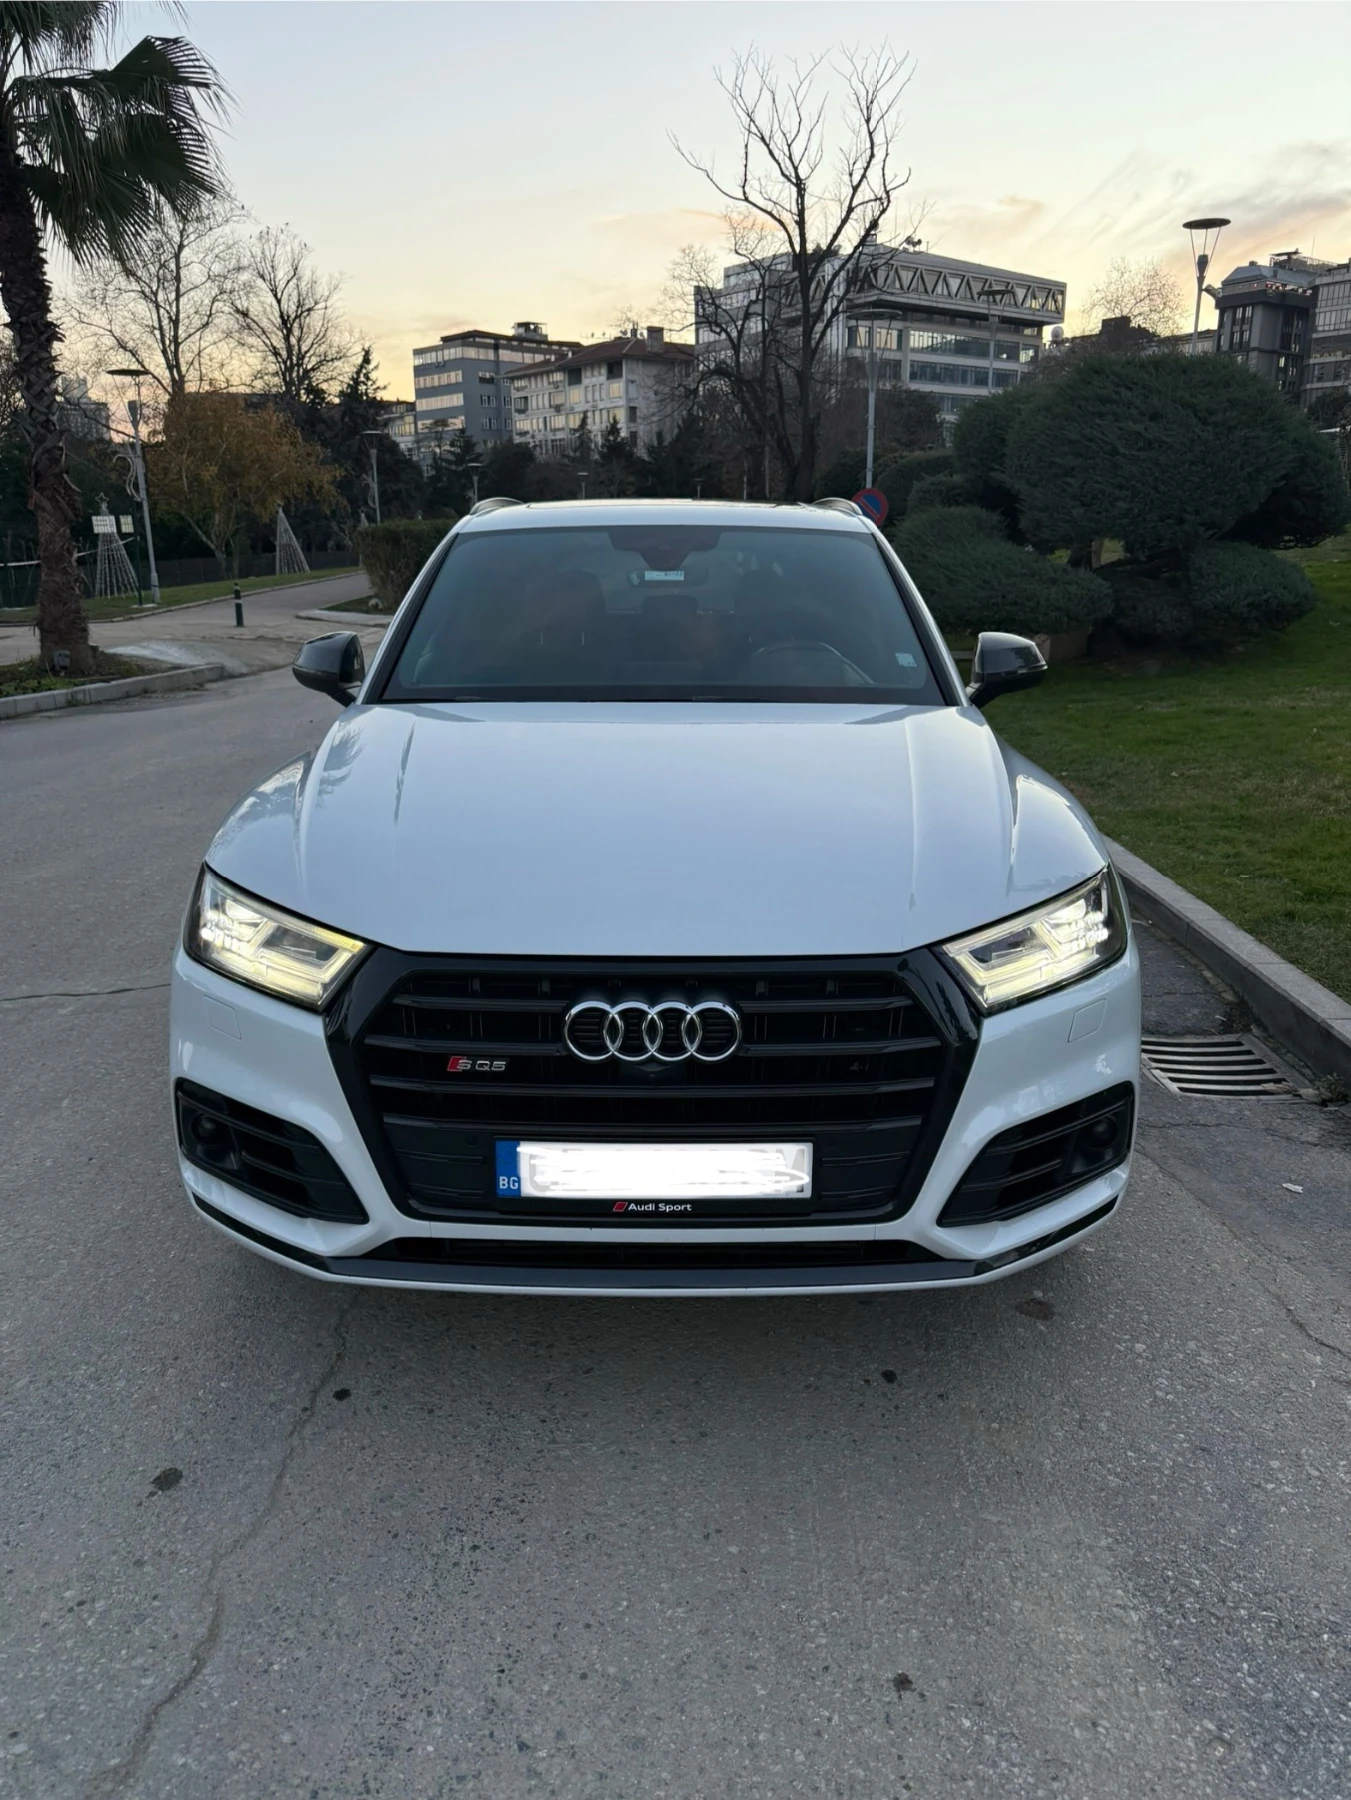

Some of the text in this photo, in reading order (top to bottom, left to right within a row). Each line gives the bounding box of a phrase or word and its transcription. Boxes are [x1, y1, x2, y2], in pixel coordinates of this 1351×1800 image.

[499, 1176, 519, 1190] BG
[627, 1203, 692, 1213] Audi Sport
